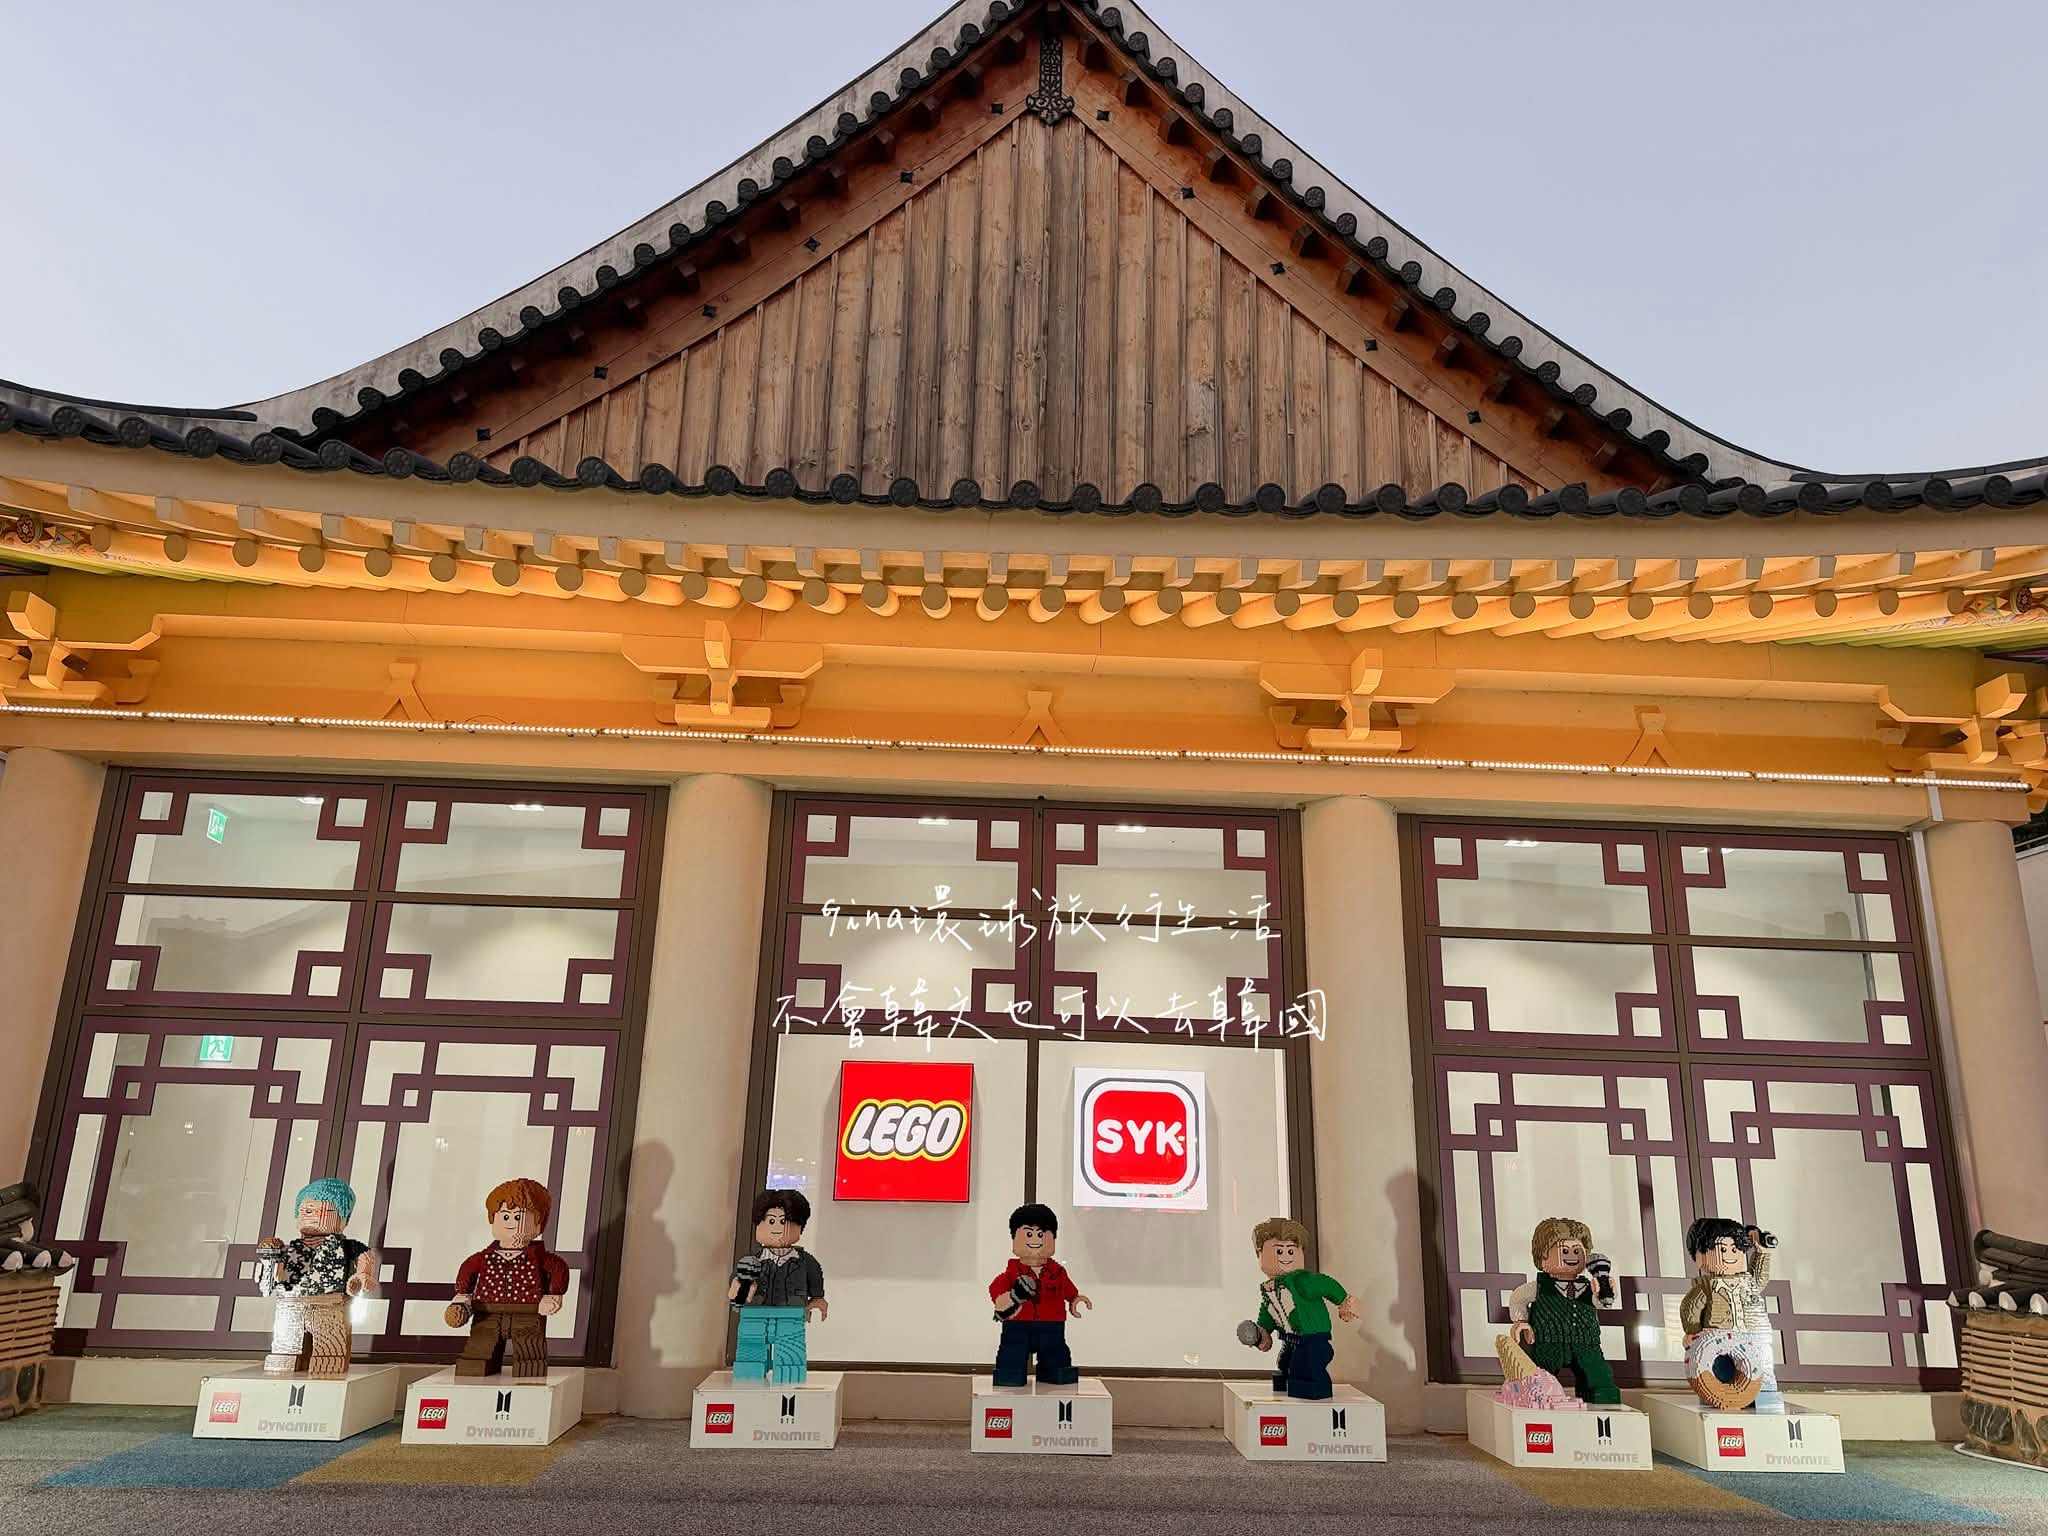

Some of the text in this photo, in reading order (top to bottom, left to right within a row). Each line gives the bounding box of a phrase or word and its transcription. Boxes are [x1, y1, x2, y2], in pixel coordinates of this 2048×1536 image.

[844, 1100, 964, 1159] LEGO
[1095, 1118, 1185, 1157] SYK
[214, 1401, 239, 1414] LEGO
[421, 1407, 447, 1421] LEGO
[707, 1412, 733, 1425] LEGO
[986, 1417, 1010, 1430] LEGO
[1261, 1425, 1286, 1438] LEGO
[1527, 1432, 1552, 1445] LEGO
[1719, 1435, 1744, 1448] LEGO
